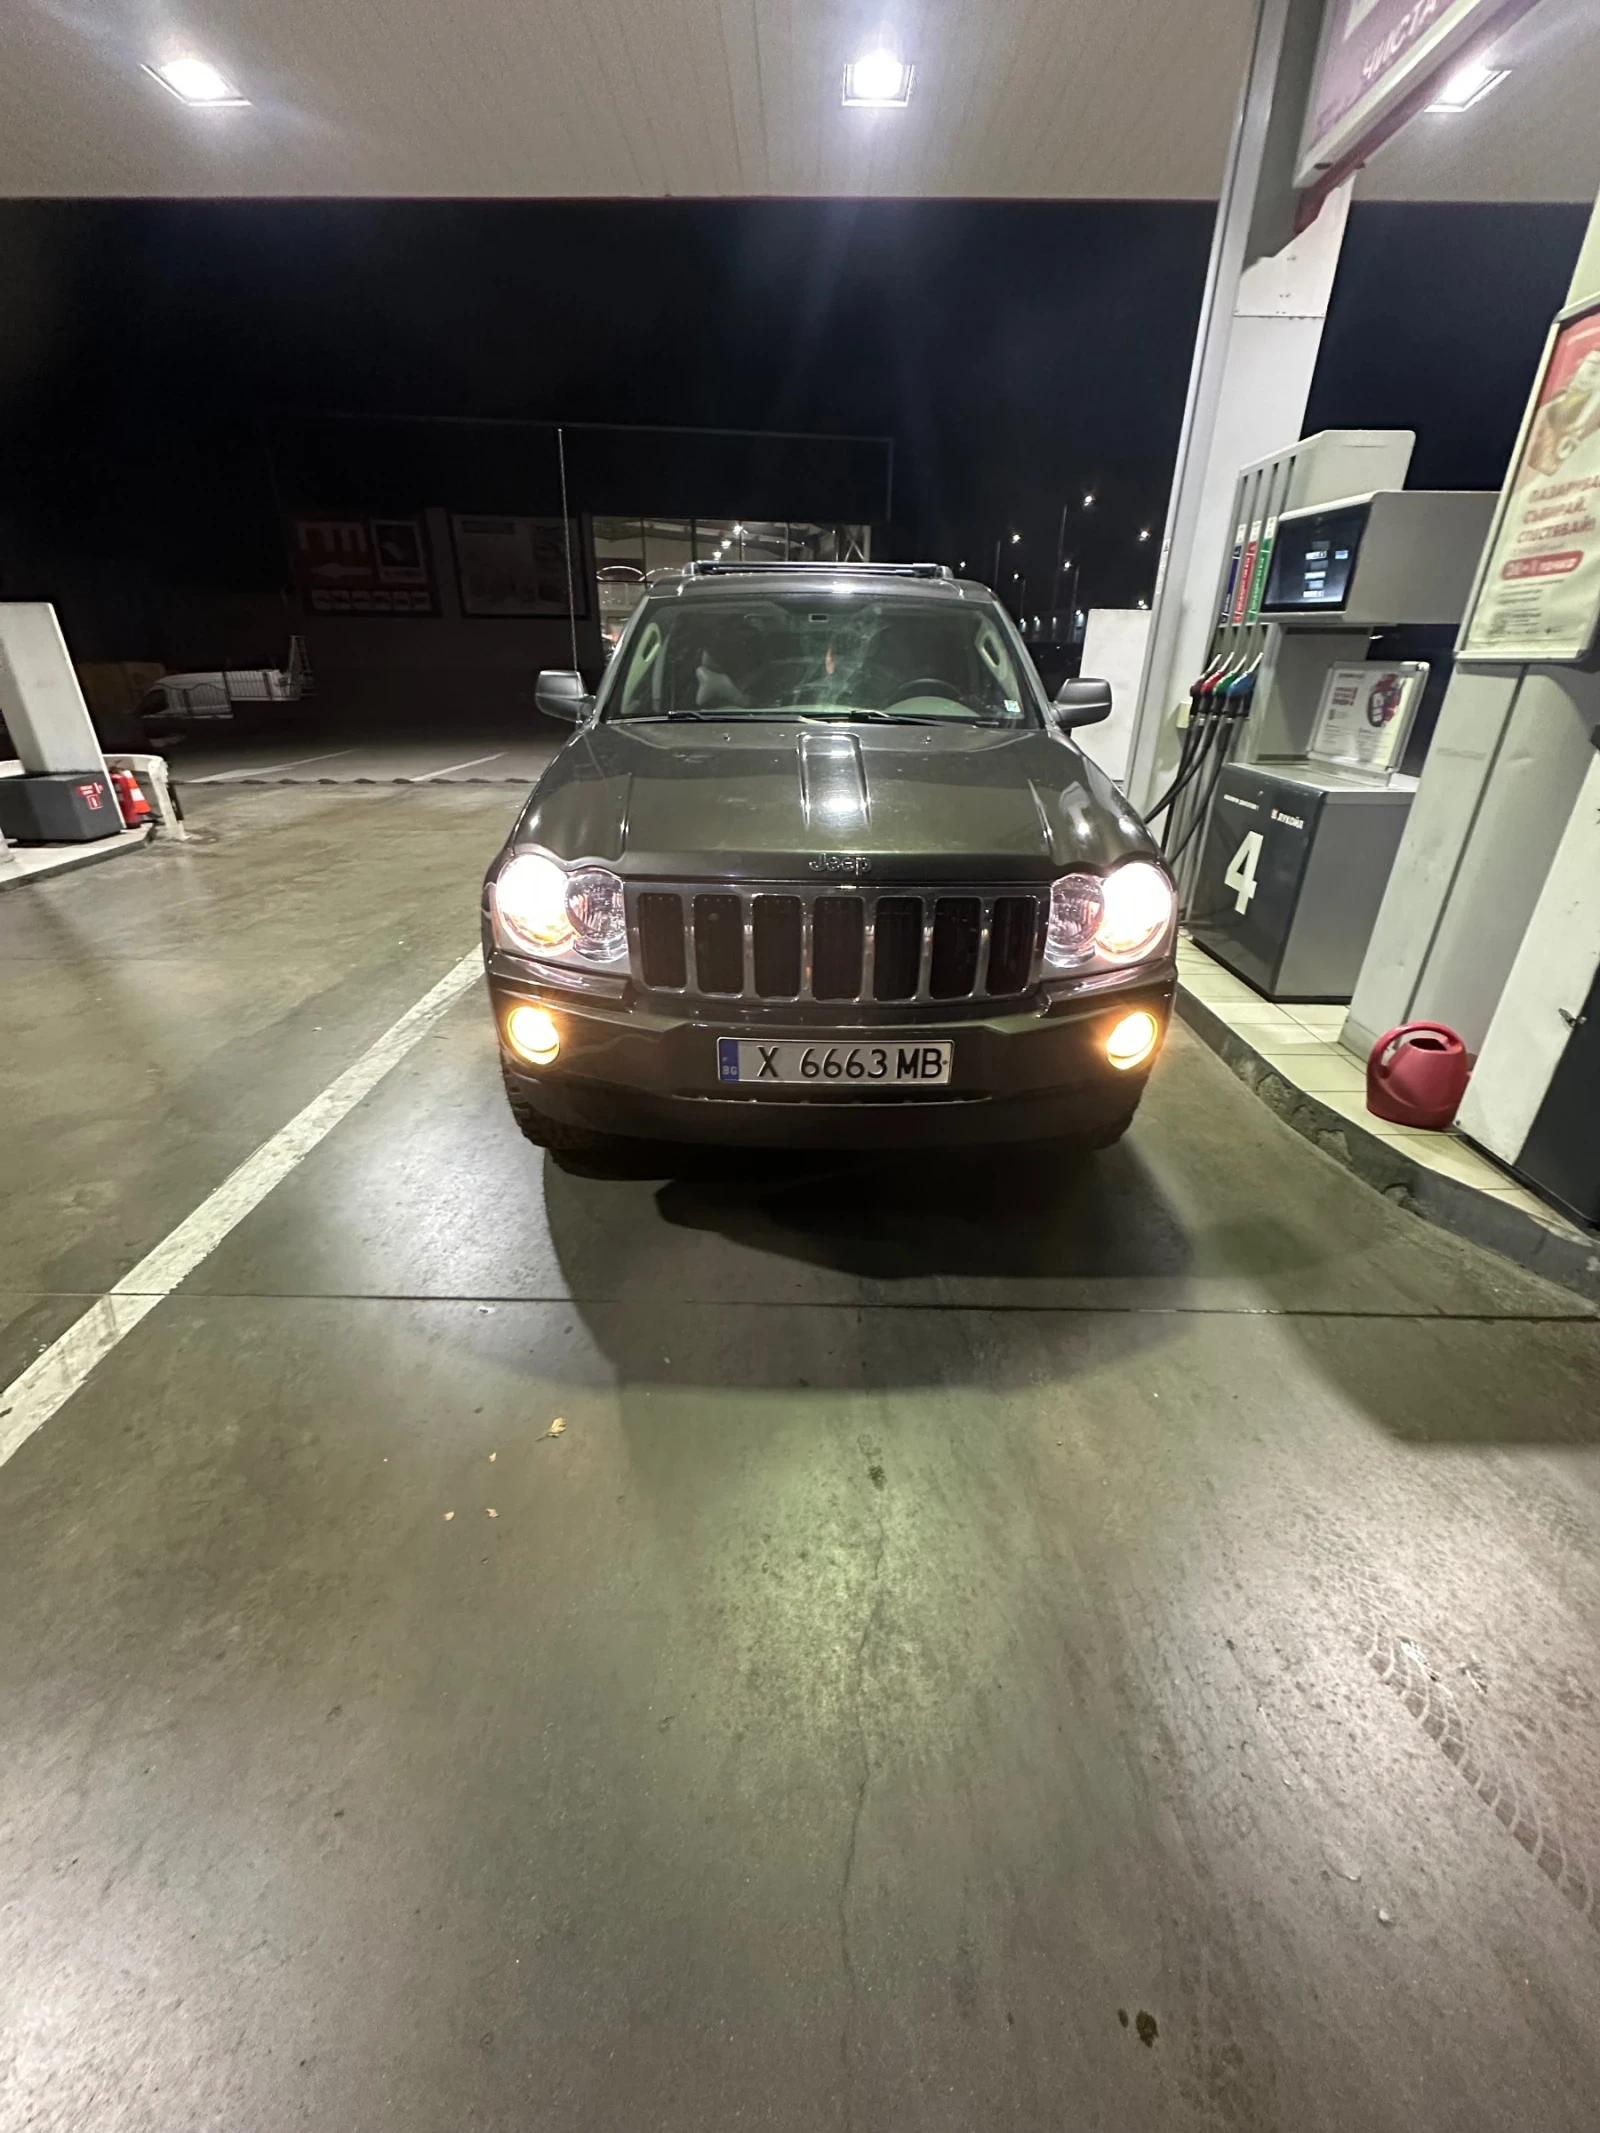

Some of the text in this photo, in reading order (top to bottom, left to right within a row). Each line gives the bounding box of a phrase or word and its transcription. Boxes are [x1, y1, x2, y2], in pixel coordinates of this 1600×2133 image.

[808, 852, 872, 876] Jeep
[1224, 831, 1264, 915] 4
[757, 1045, 943, 1079] X 6663 MB
